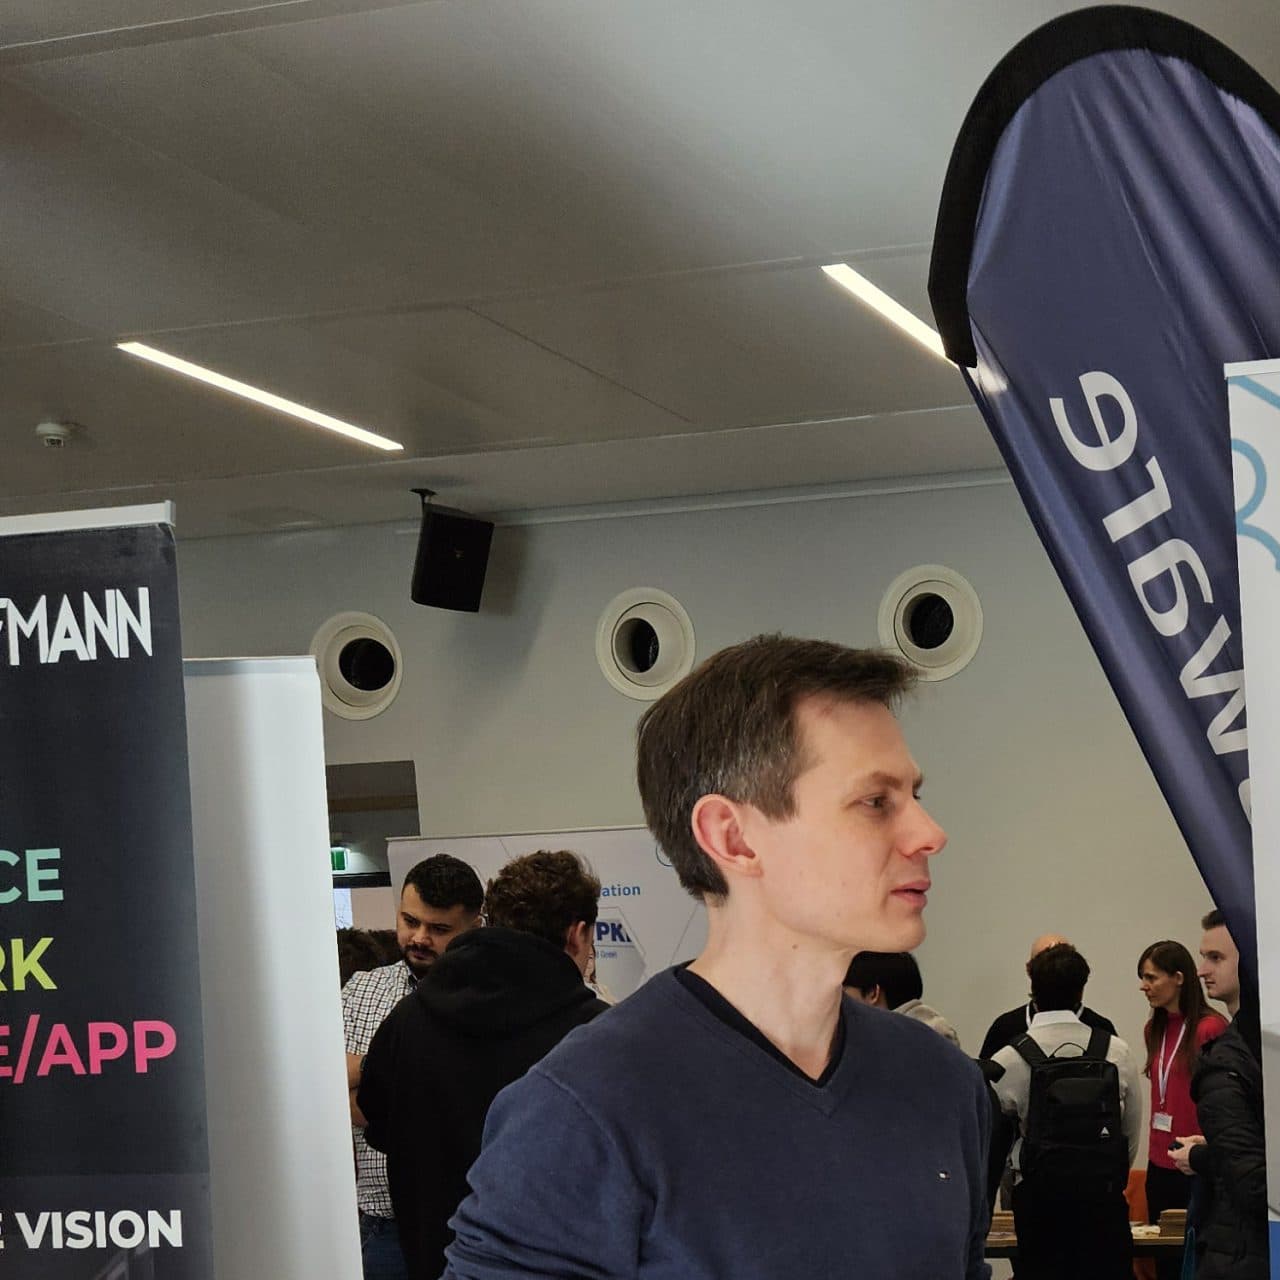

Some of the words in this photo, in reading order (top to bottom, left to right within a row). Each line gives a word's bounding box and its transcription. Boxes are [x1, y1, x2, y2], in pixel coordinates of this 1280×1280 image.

[0, 587, 153, 665] MANN
[0, 937, 58, 991] K
[15, 1210, 183, 1249] VISION
